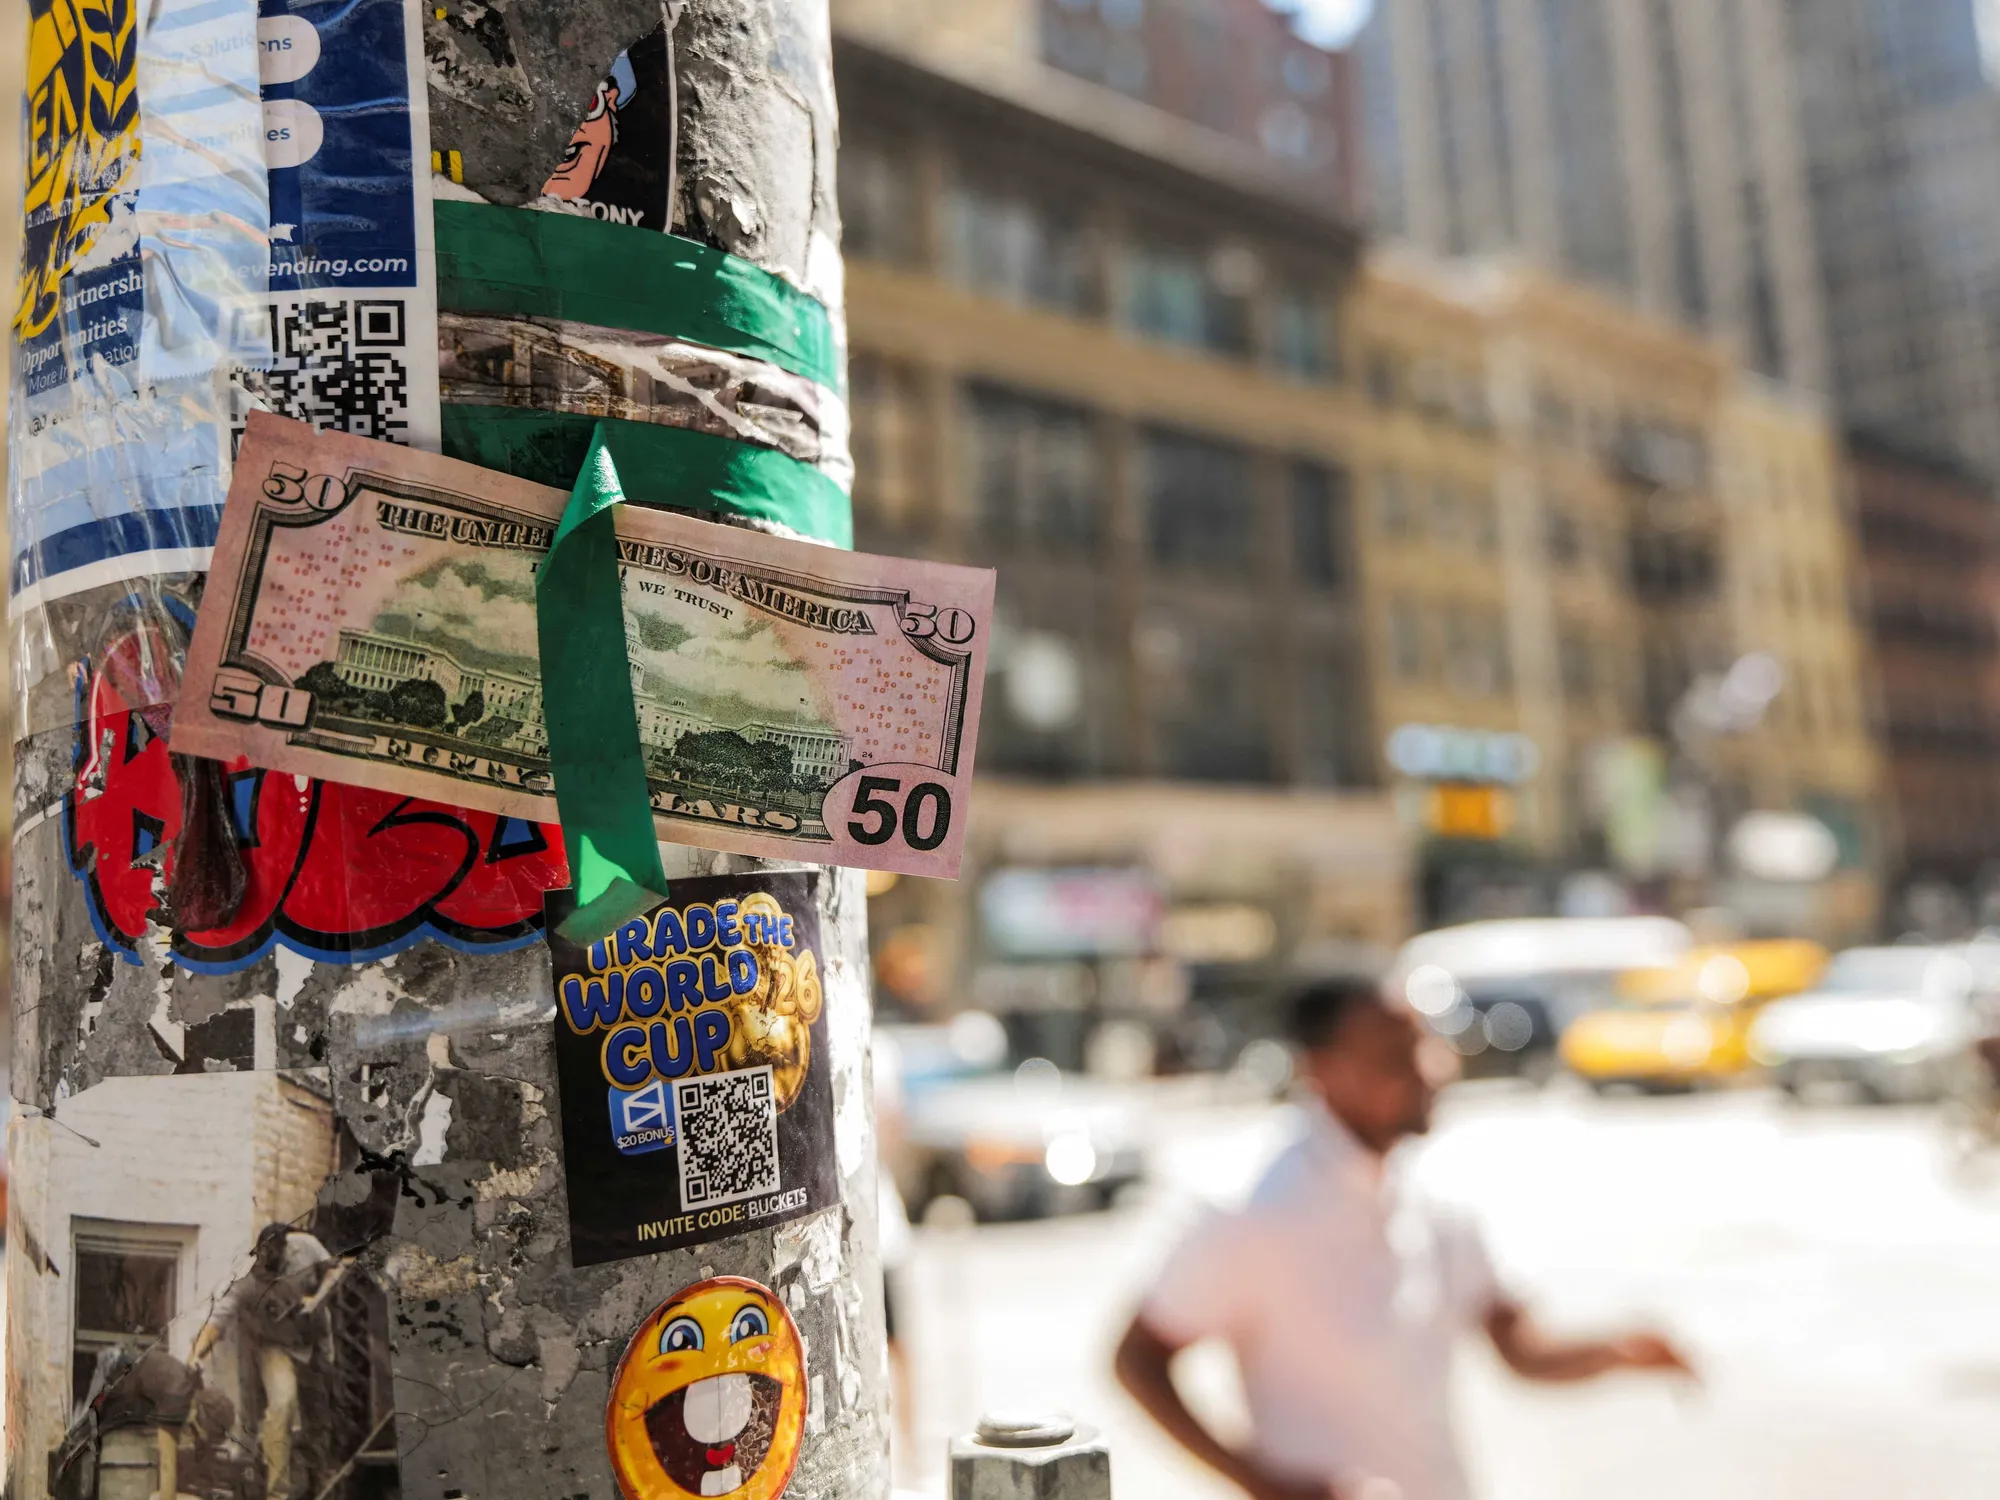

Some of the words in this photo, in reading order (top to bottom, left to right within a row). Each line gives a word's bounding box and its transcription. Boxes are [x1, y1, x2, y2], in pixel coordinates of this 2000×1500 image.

[28, 363, 57, 393] More
[262, 460, 350, 512] 50
[376, 500, 449, 541] THE
[689, 559, 732, 597] OF
[731, 573, 877, 636] AMERICA
[638, 580, 666, 596] WE
[674, 588, 733, 621] TRUST
[900, 601, 976, 644] 50
[209, 673, 319, 732] 50
[862, 751, 873, 759] 24
[650, 787, 804, 832] LARS
[847, 776, 952, 851] 50
[588, 899, 744, 973] TRADE
[742, 913, 794, 948] THE
[561, 949, 760, 1033] WORLD
[603, 1006, 733, 1088] CUP
[617, 1135, 638, 1150] $20
[638, 1126, 676, 1144] BONUS
[637, 1214, 696, 1241] INVITE
[698, 1204, 747, 1229] CODE:
[748, 1187, 808, 1218] BUCKETS
